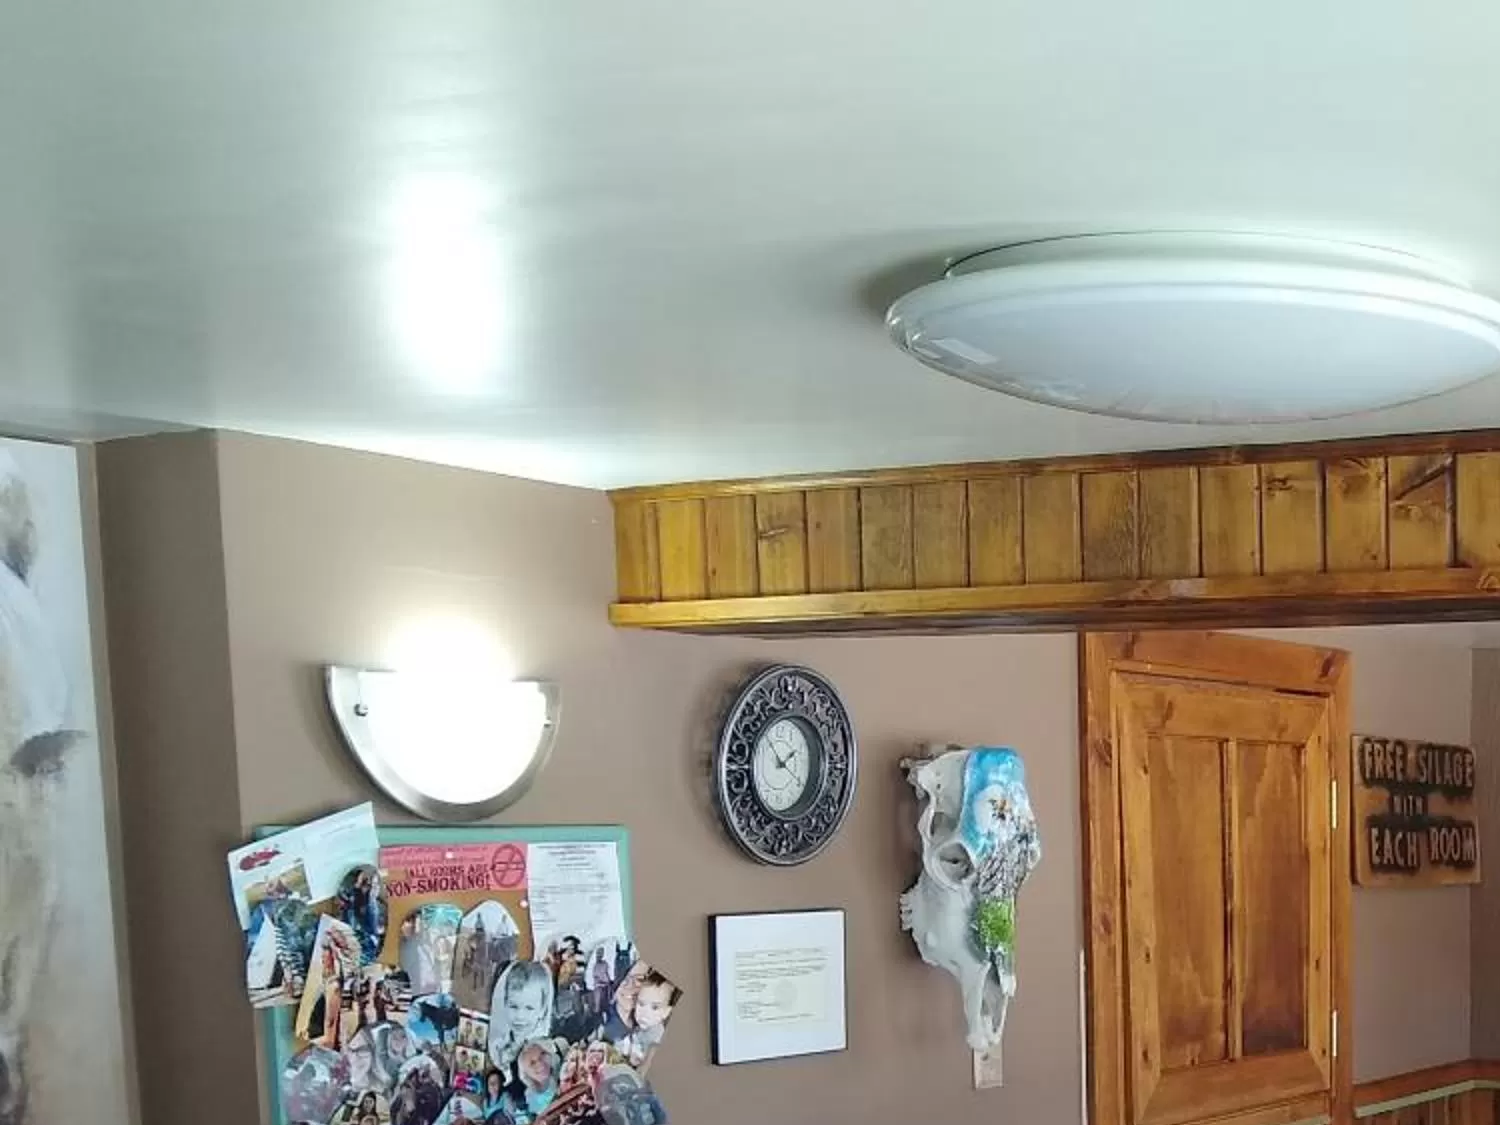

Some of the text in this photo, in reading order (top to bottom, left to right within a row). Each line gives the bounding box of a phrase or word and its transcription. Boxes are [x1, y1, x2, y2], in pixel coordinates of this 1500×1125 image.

[1362, 742, 1474, 788] FREE SILAGE
[1392, 794, 1424, 818] WITH
[1370, 826, 1475, 867] EACH ROOM
[430, 864, 465, 878] ROOMS
[467, 863, 489, 874] ARE
